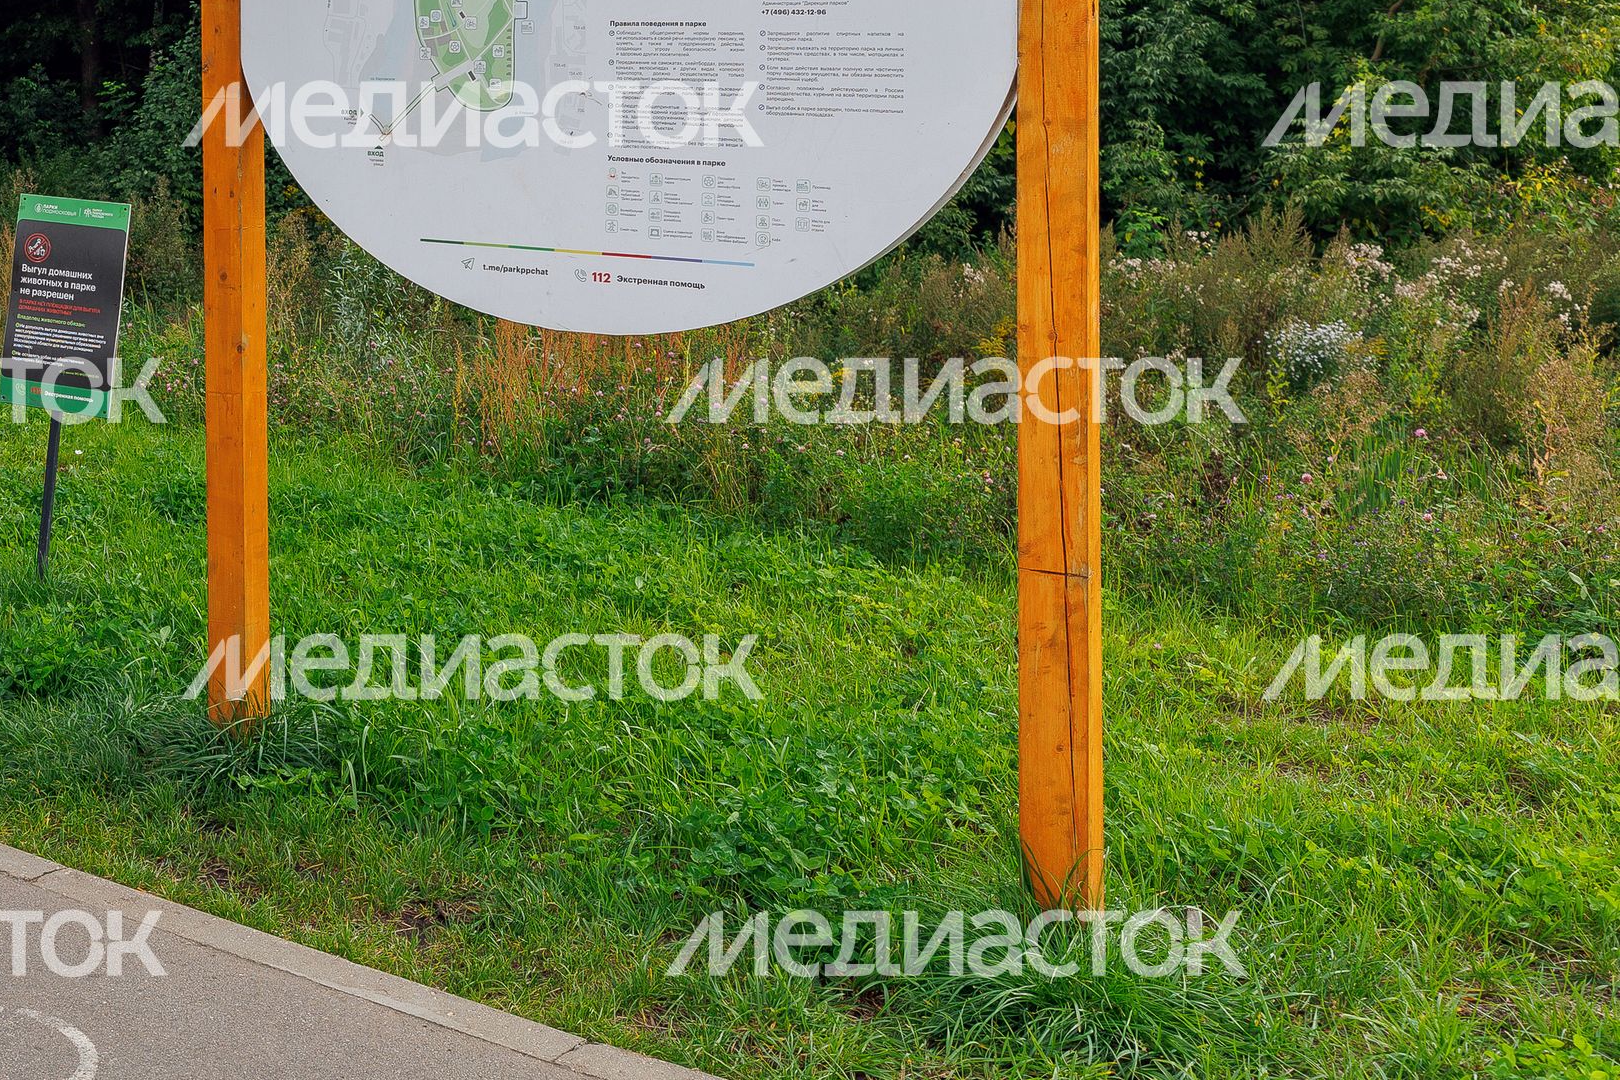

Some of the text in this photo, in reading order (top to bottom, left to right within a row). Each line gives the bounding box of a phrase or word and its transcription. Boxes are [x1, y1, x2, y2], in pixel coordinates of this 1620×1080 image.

[645, 157, 695, 165] обозначения
[22, 263, 92, 280] Выгул домашних
[483, 263, 548, 275] t.me/parkppchat
[20, 276, 63, 287] животных
[71, 282, 96, 292] парке
[592, 273, 611, 282] 112
[617, 275, 705, 289] Экстренная помощь
[20, 287, 74, 300] не разрешен
